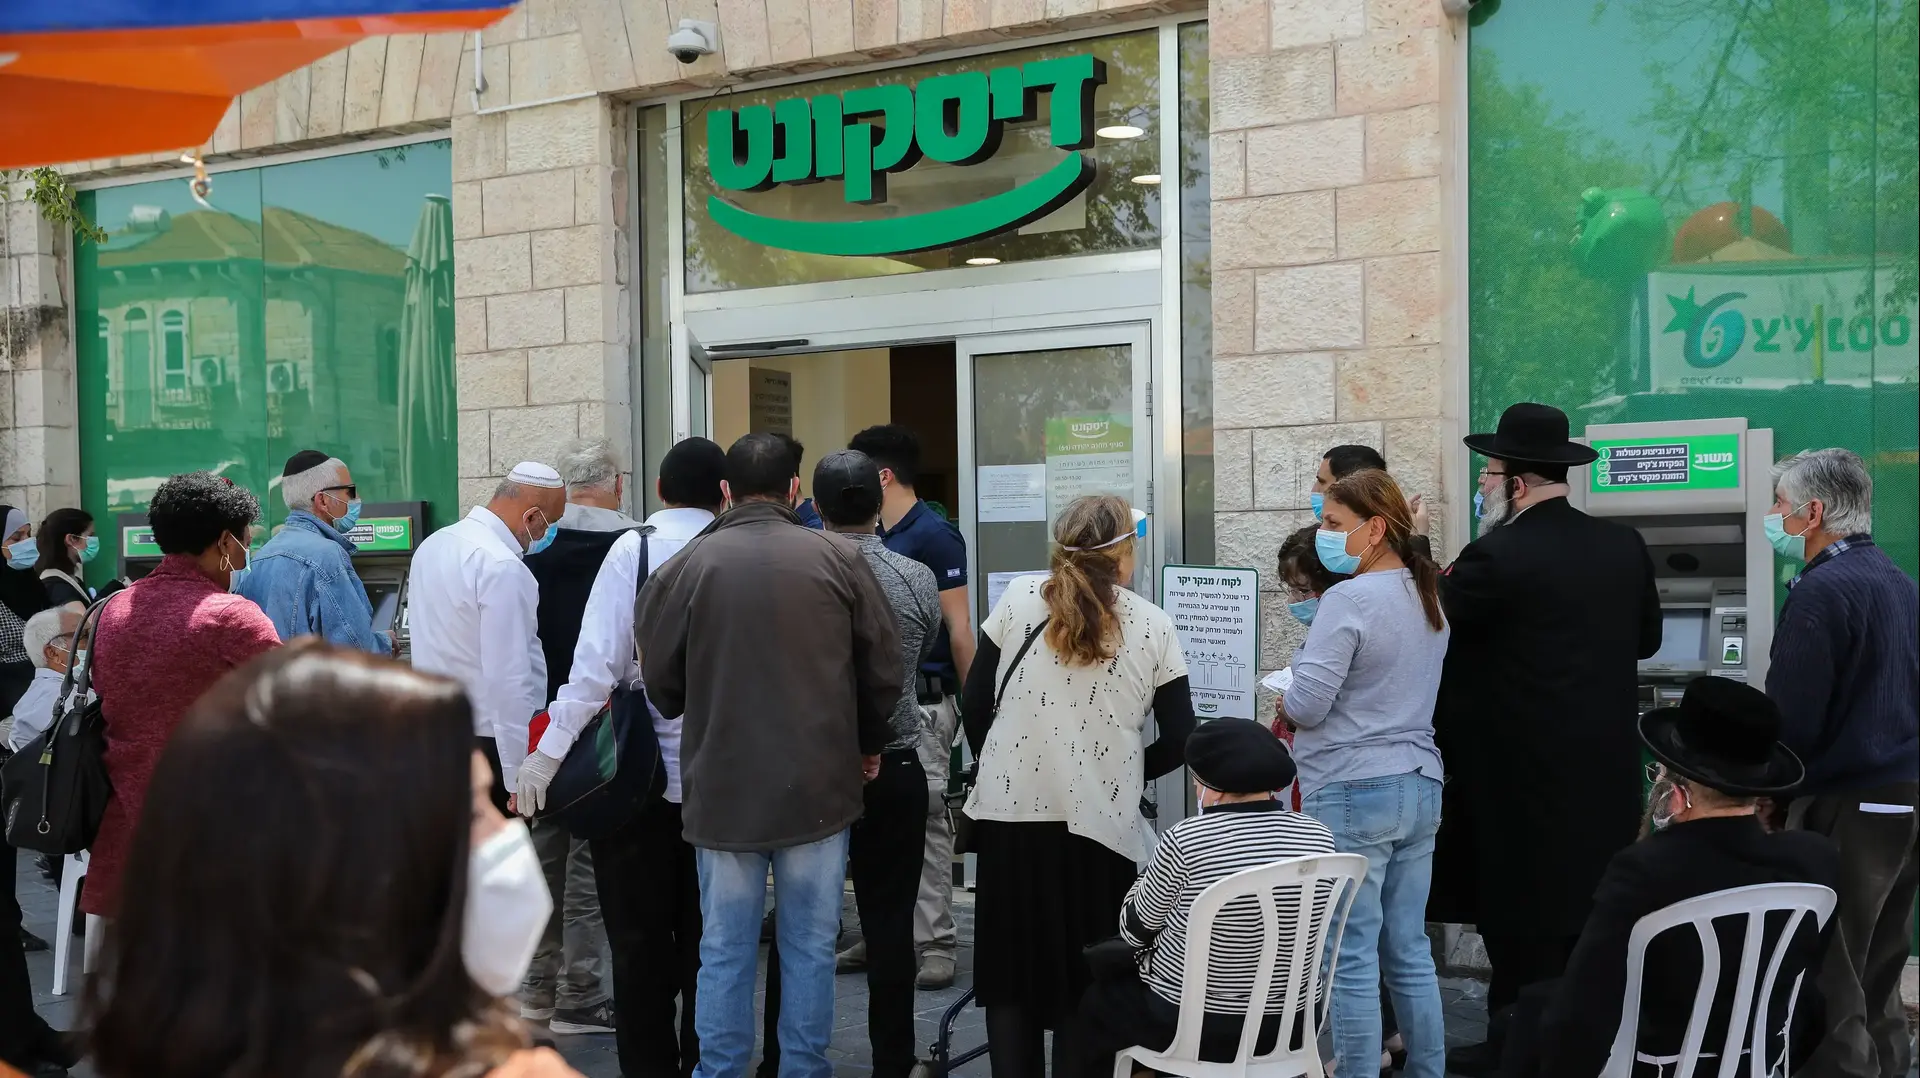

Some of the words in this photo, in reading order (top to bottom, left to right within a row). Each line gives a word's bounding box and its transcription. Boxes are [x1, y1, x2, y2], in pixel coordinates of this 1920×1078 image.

[707, 54, 1106, 203] דיסקונט
[1071, 421, 1109, 433] דיסקונט
[1109, 441, 1124, 449] סניף
[1615, 448, 1641, 457] פעולות
[1642, 448, 1665, 456] וביצוע
[1694, 452, 1733, 464] משוב
[1637, 461, 1658, 470] צ'קים
[1658, 460, 1684, 469] הפקדת
[1617, 474, 1638, 484] צ'קים
[1638, 473, 1661, 482] פנקסי
[1661, 472, 1684, 480] הזמנת
[1177, 576, 1191, 586] יקר
[1193, 576, 1215, 587] מבקר
[1221, 577, 1242, 588] לקוח
[1199, 592, 1221, 600] להמשיך
[1230, 605, 1240, 613] תוך
[1175, 613, 1188, 621] בחוץ
[1189, 614, 1209, 622] להמתין
[1199, 691, 1217, 699] שיתוף
[1217, 692, 1226, 700] על
